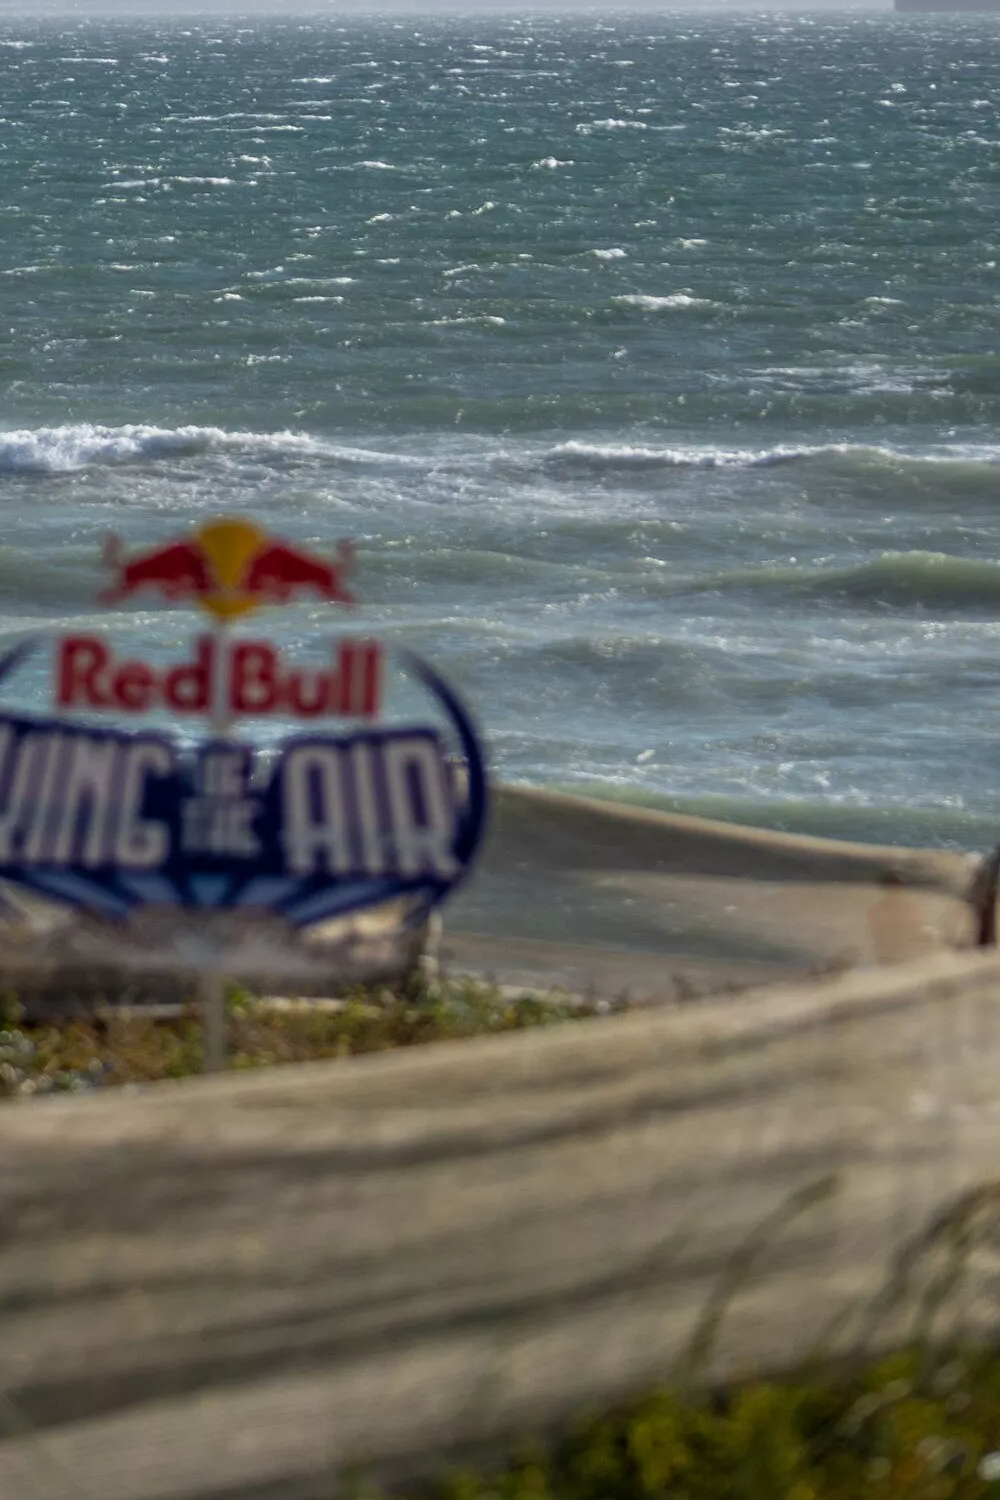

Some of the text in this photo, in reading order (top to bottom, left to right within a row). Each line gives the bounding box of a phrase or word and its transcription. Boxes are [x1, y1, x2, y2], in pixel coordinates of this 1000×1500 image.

[55, 634, 380, 719] Red Bull
[282, 740, 463, 876] AIR
